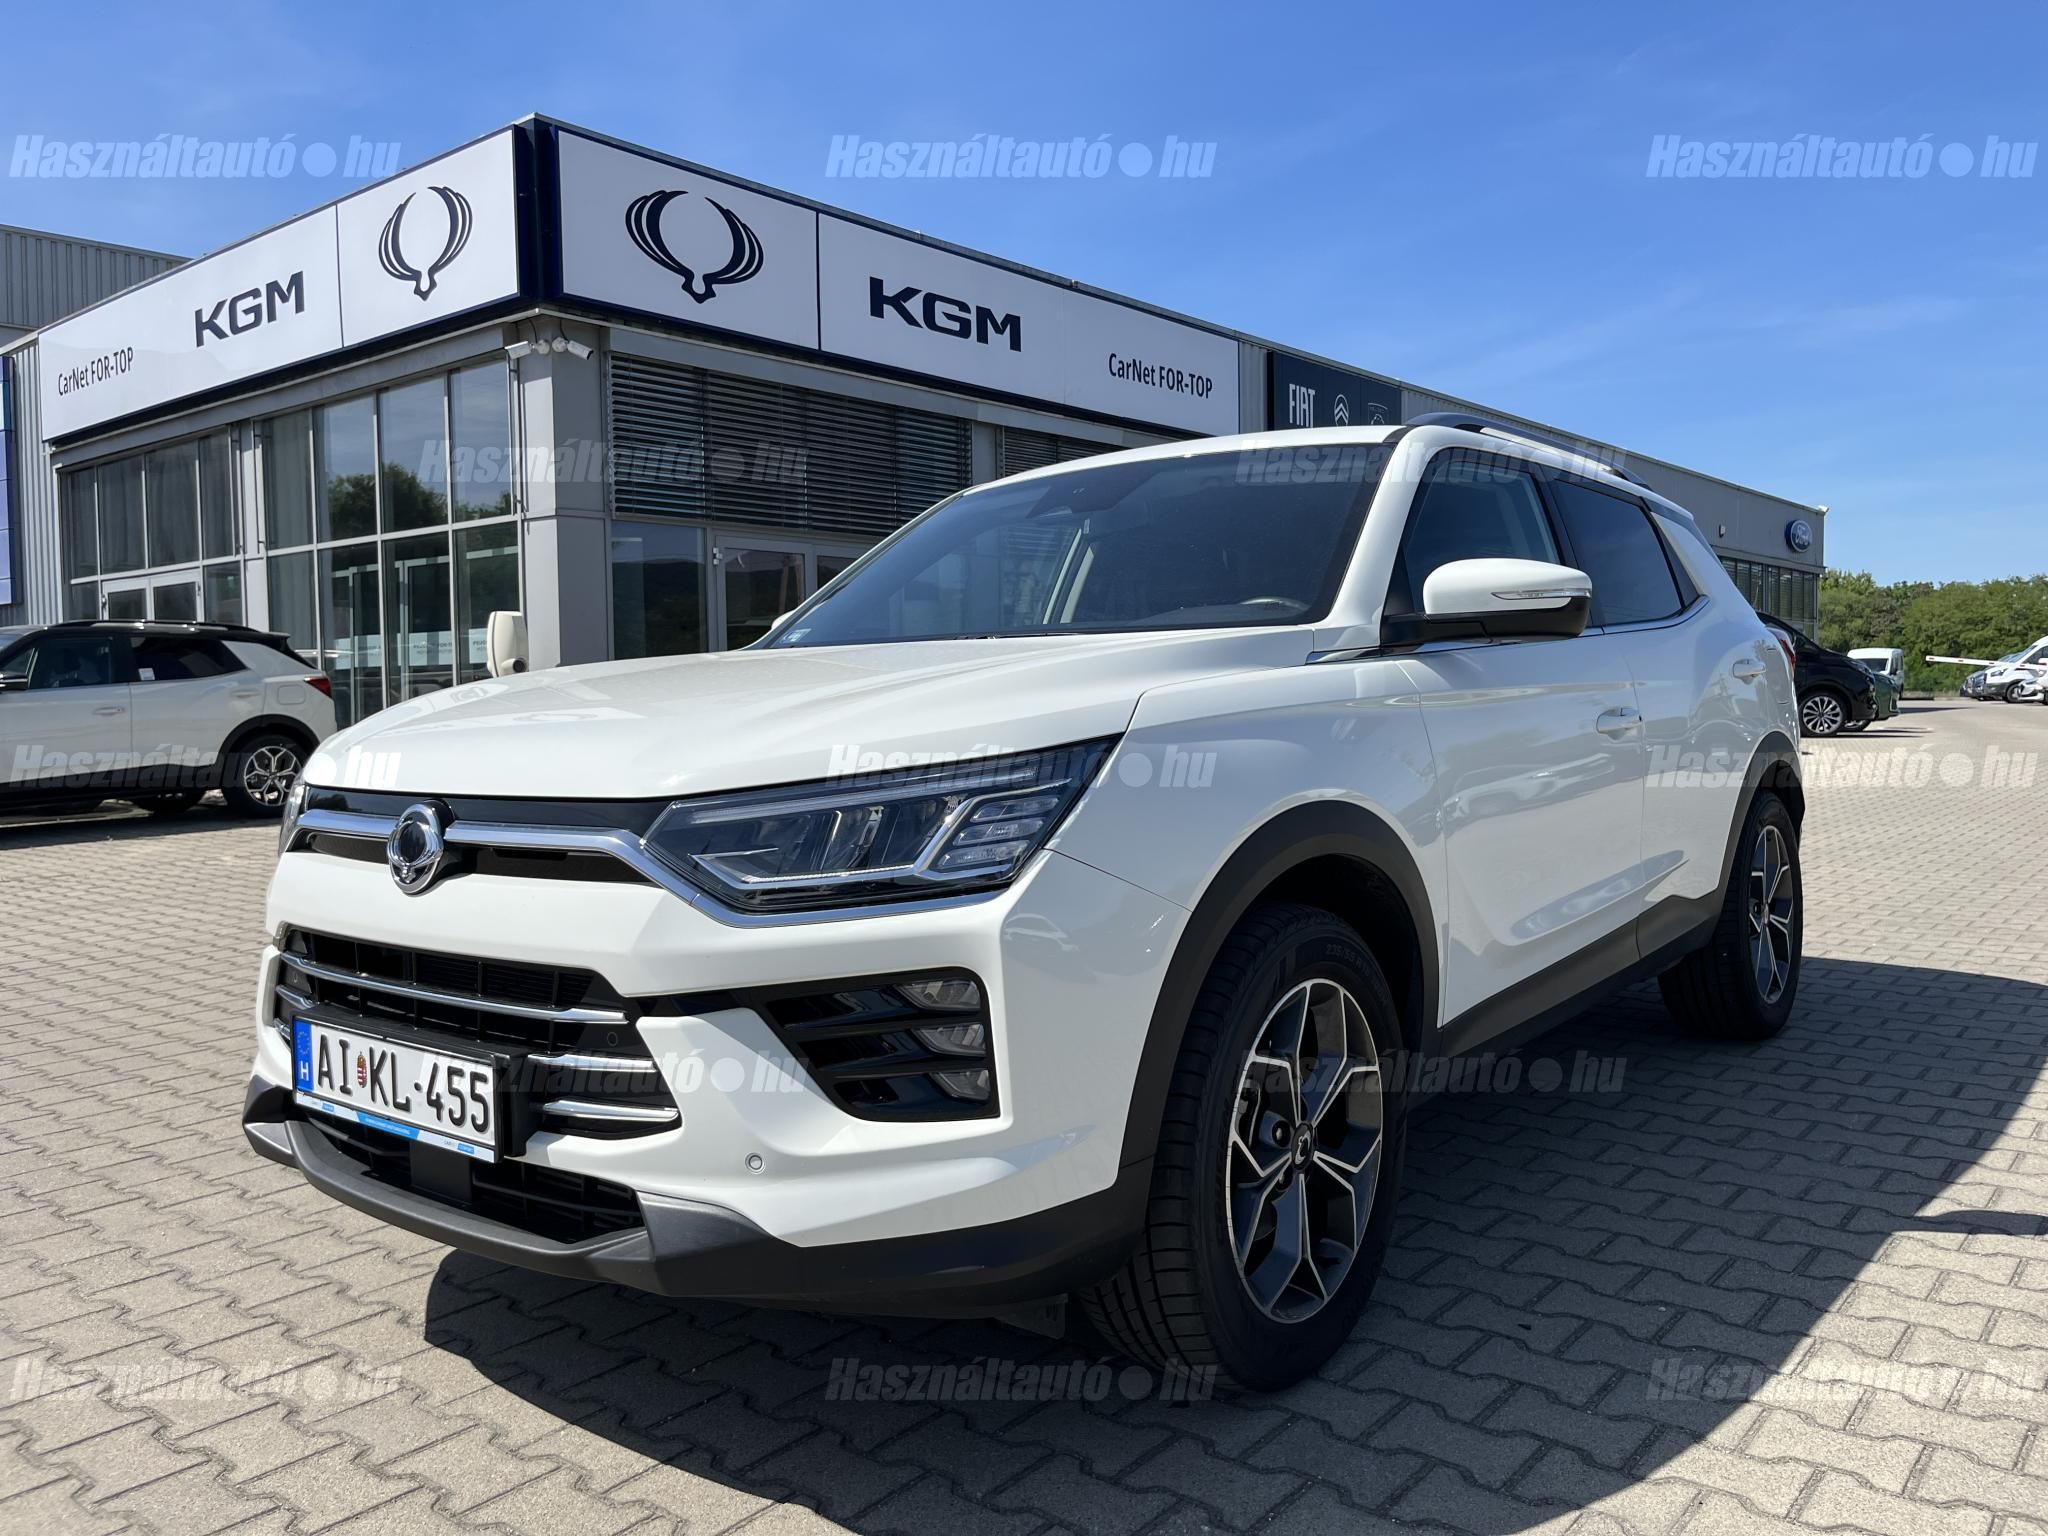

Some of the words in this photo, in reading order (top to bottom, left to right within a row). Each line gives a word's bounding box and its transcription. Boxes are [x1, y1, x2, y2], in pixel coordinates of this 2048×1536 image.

[194, 271, 305, 348] KGM
[869, 276, 1022, 353] KGM
[58, 366, 89, 396] CarNet
[91, 346, 134, 385] FOR-TOP
[1108, 352, 1156, 387] CarNet
[1159, 365, 1213, 400] FOR-TOP
[1288, 383, 1316, 429] FIAT
[299, 1060, 311, 1083] H
